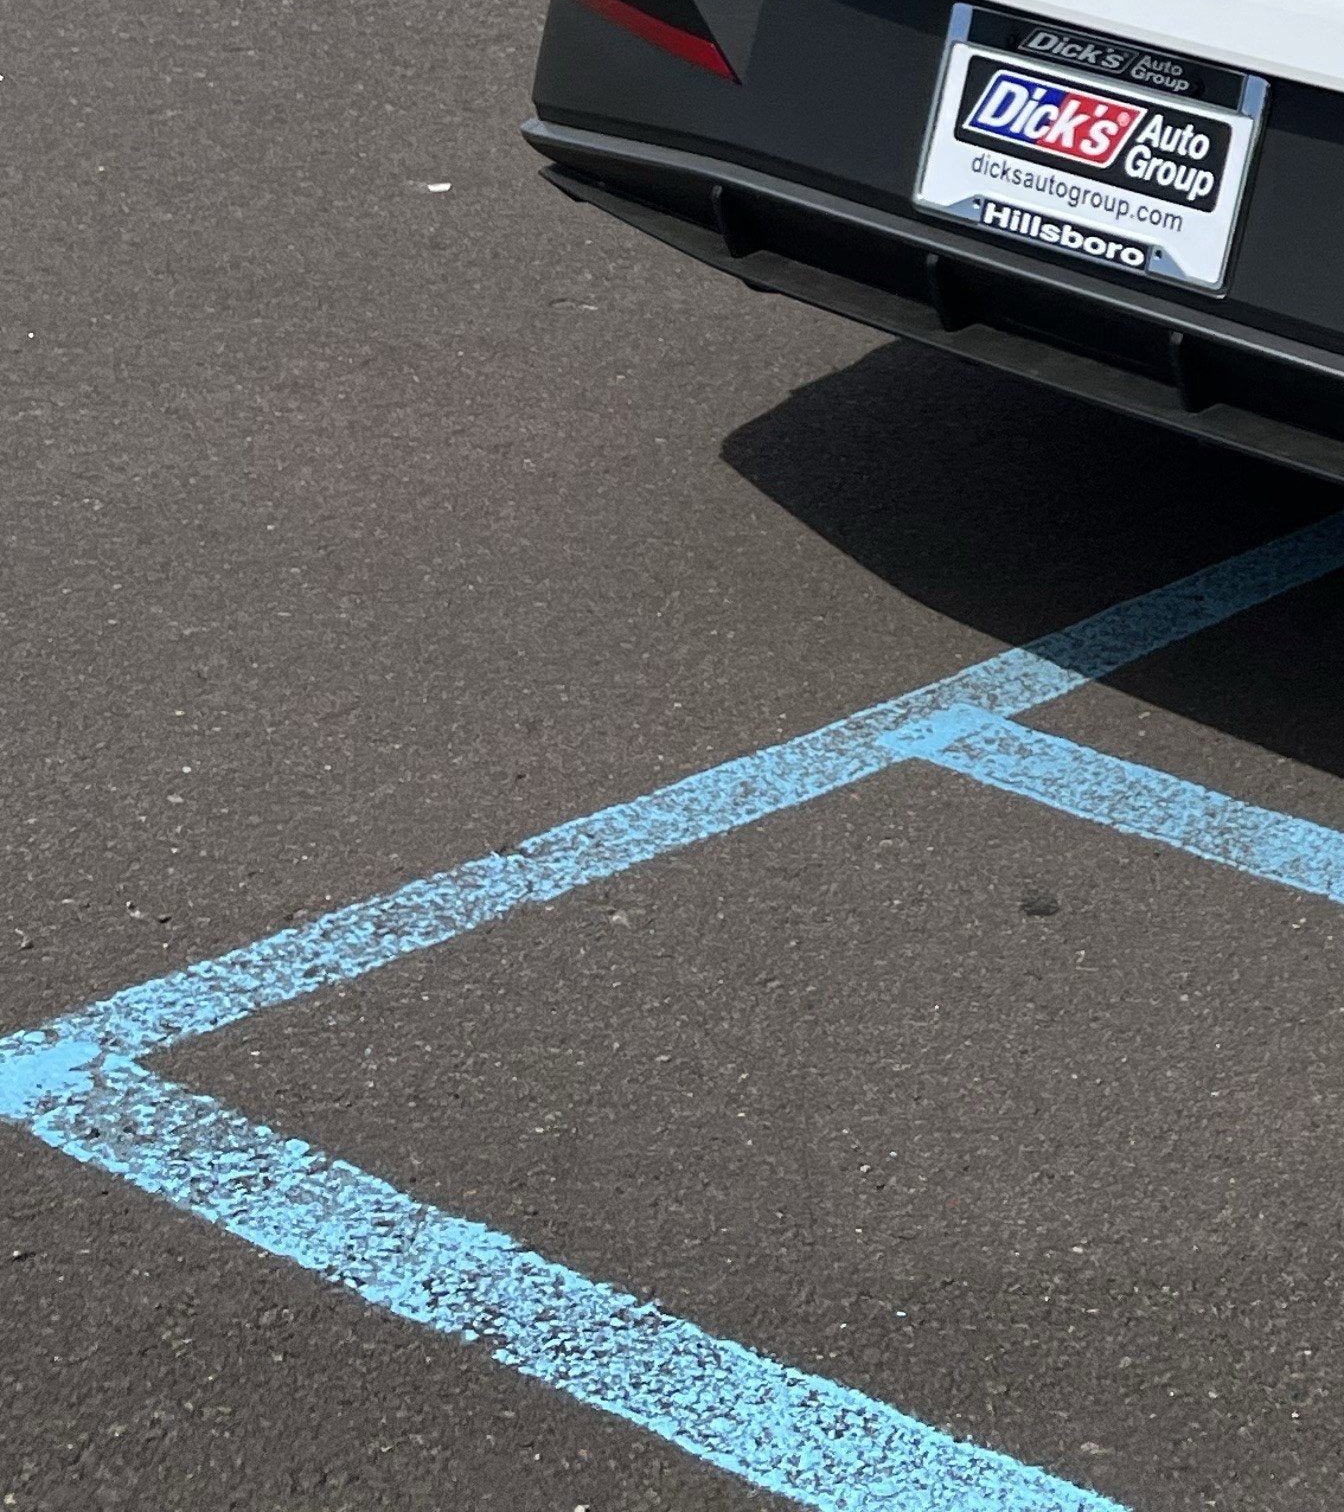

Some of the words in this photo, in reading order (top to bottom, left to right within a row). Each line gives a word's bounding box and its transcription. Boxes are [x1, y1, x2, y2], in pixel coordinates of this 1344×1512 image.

[1027, 31, 1125, 68] Dick's
[1138, 55, 1183, 76] Auto
[1130, 66, 1190, 92] Group
[1136, 114, 1210, 160] Auto
[971, 152, 1183, 232] dicksautogroup.com
[1125, 145, 1216, 201] Group
[983, 201, 1145, 267] Hillsboro
